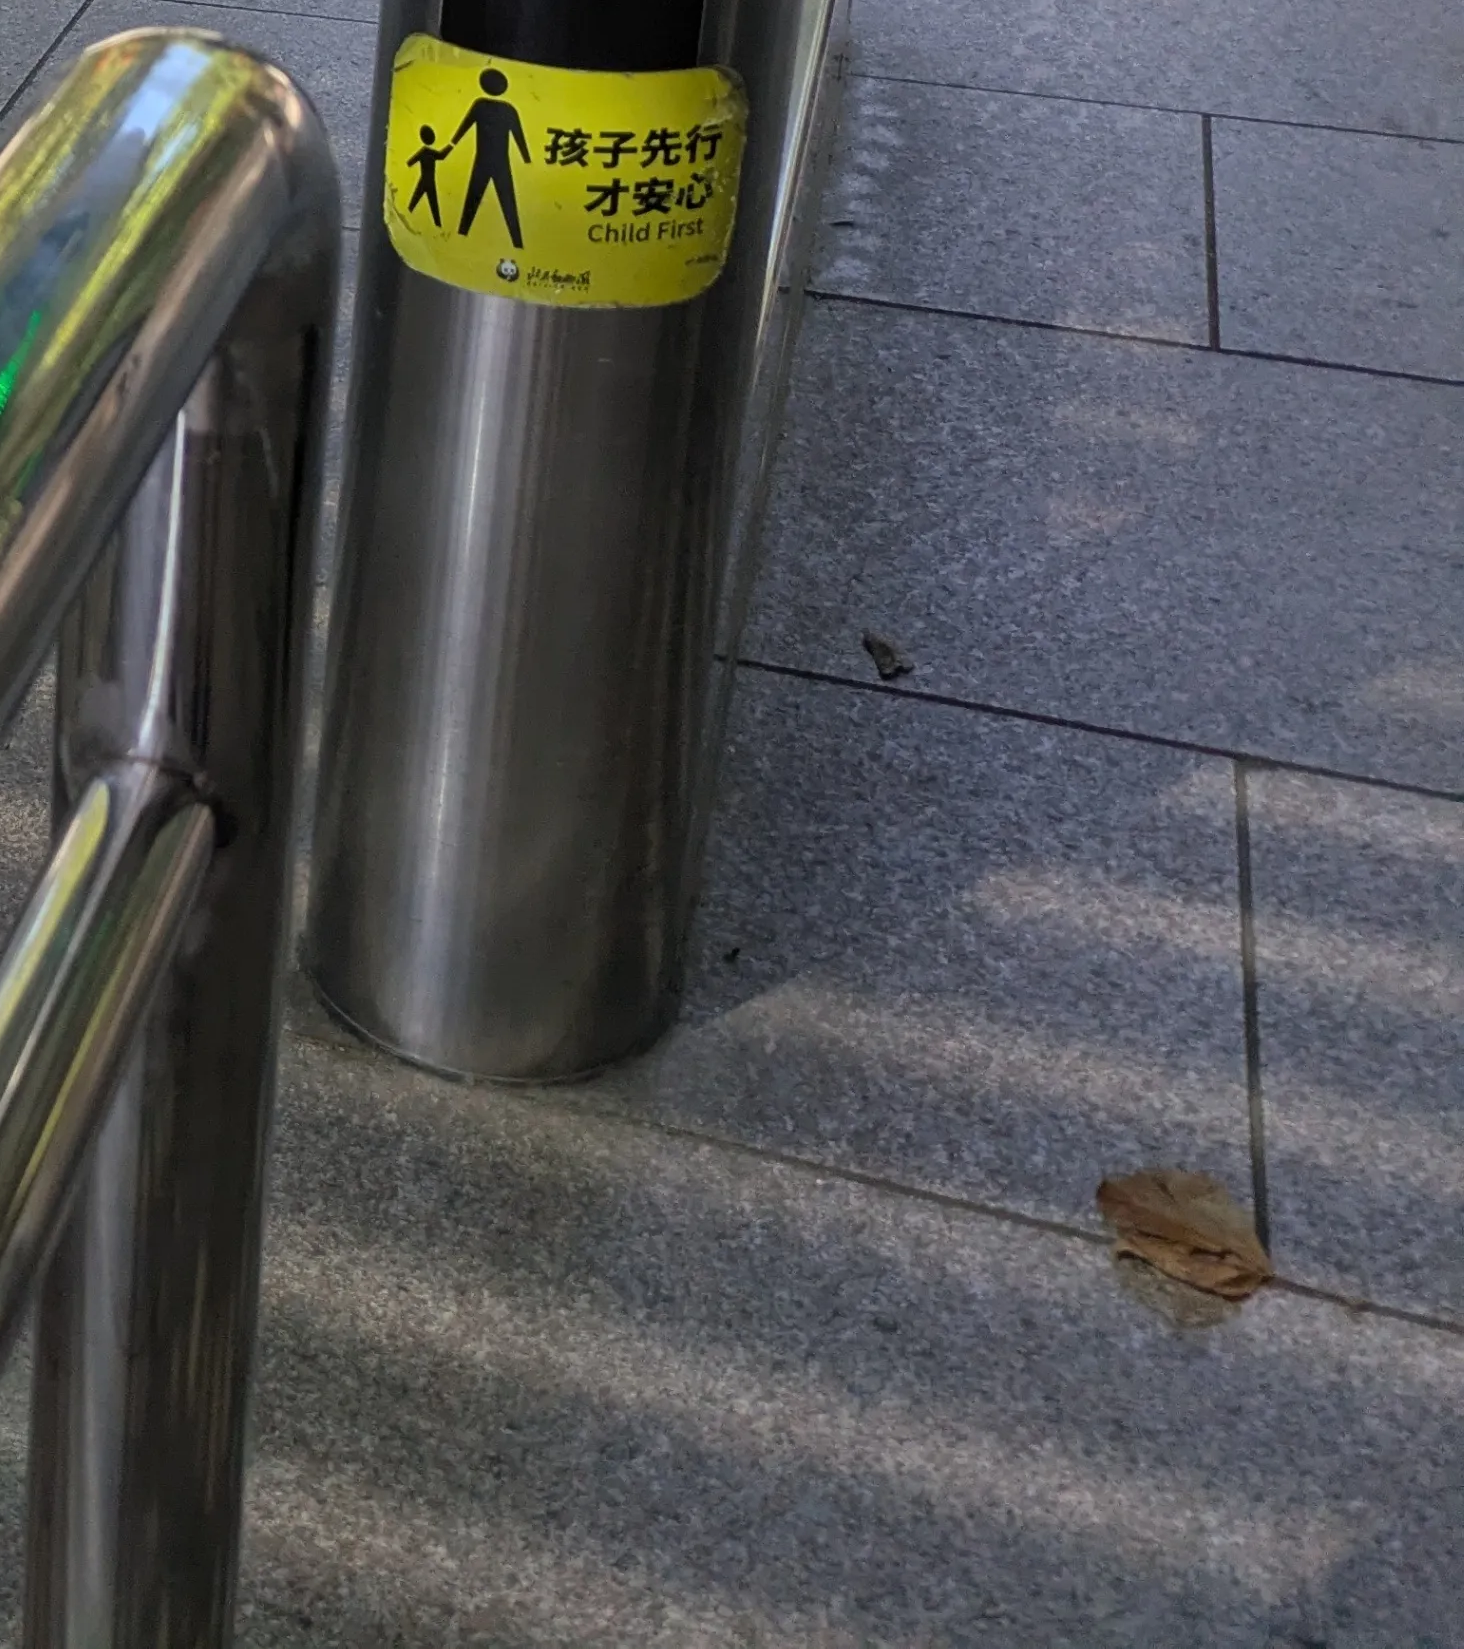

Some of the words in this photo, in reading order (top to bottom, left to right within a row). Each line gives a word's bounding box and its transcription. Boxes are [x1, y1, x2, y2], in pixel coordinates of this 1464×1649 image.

[544, 125, 724, 168] 孩子先行
[584, 173, 714, 217] 才安心
[587, 220, 650, 243] Child
[658, 217, 704, 239] First
